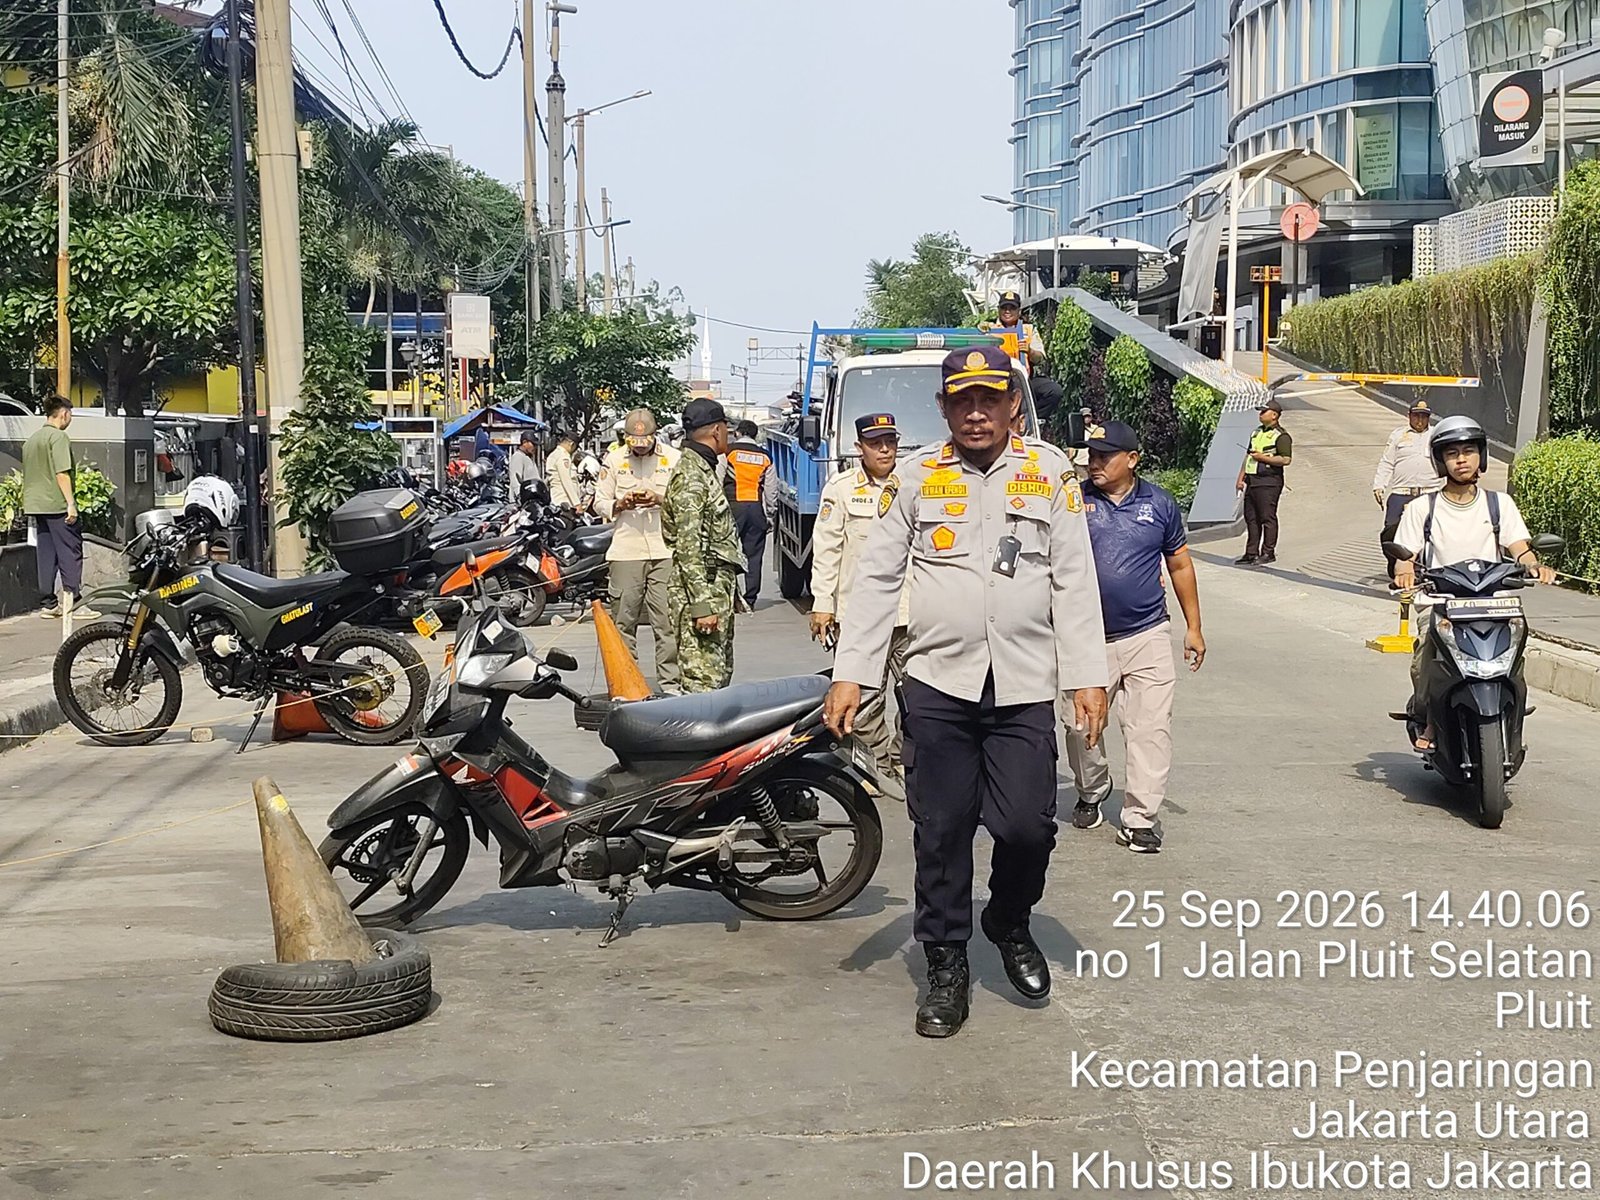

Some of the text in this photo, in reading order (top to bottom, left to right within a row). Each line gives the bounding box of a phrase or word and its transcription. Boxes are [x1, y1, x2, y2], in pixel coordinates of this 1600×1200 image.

[1493, 122, 1530, 133] DILARANG
[1498, 131, 1526, 142] MASUK
[460, 326, 481, 335] ATM
[1009, 483, 1049, 496] DISHUB
[159, 575, 200, 599] BABINSA
